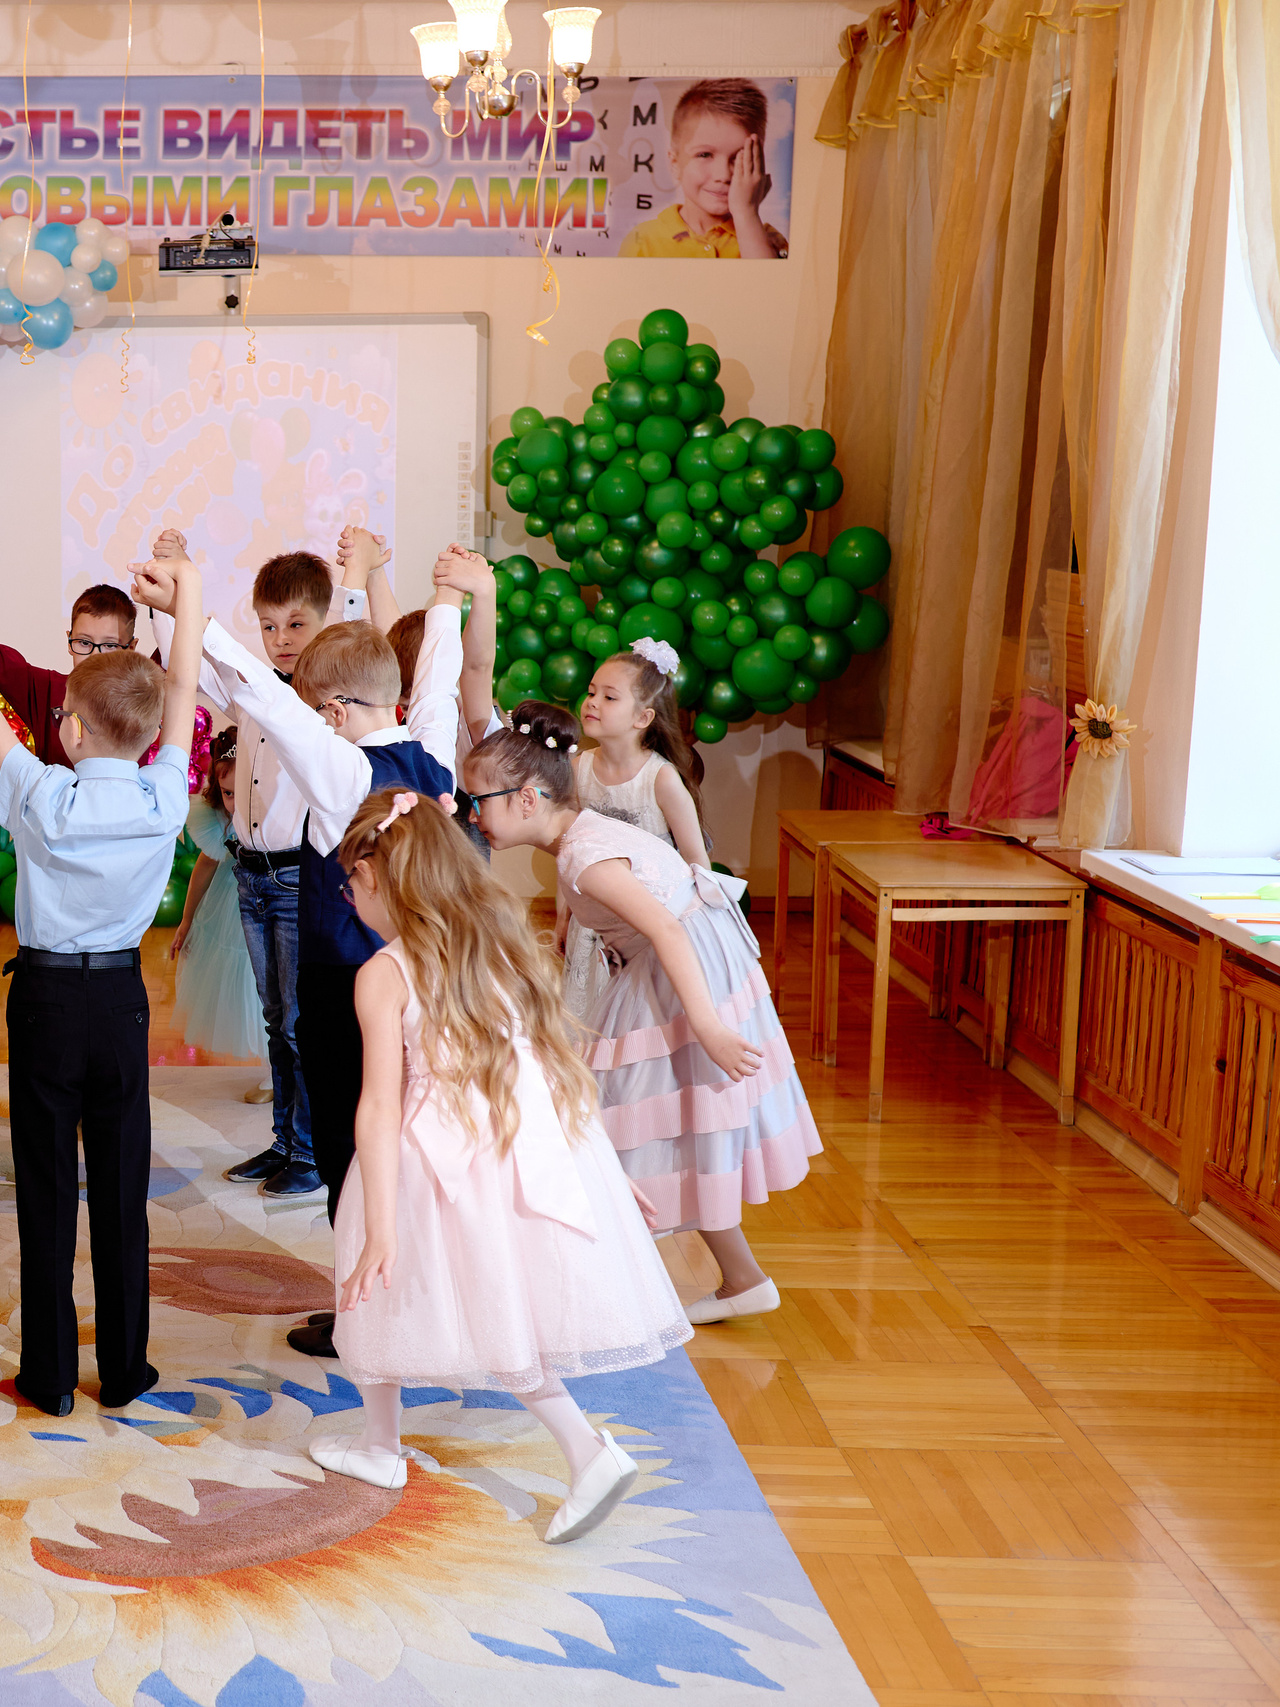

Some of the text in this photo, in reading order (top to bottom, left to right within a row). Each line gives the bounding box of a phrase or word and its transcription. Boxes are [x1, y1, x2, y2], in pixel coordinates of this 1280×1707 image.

[632, 102, 658, 127] М
[161, 108, 430, 170] ВИДЕТЬ
[449, 108, 596, 161] МИР
[633, 154, 655, 173] К
[272, 175, 608, 229] ГЛАЗАМИ!
